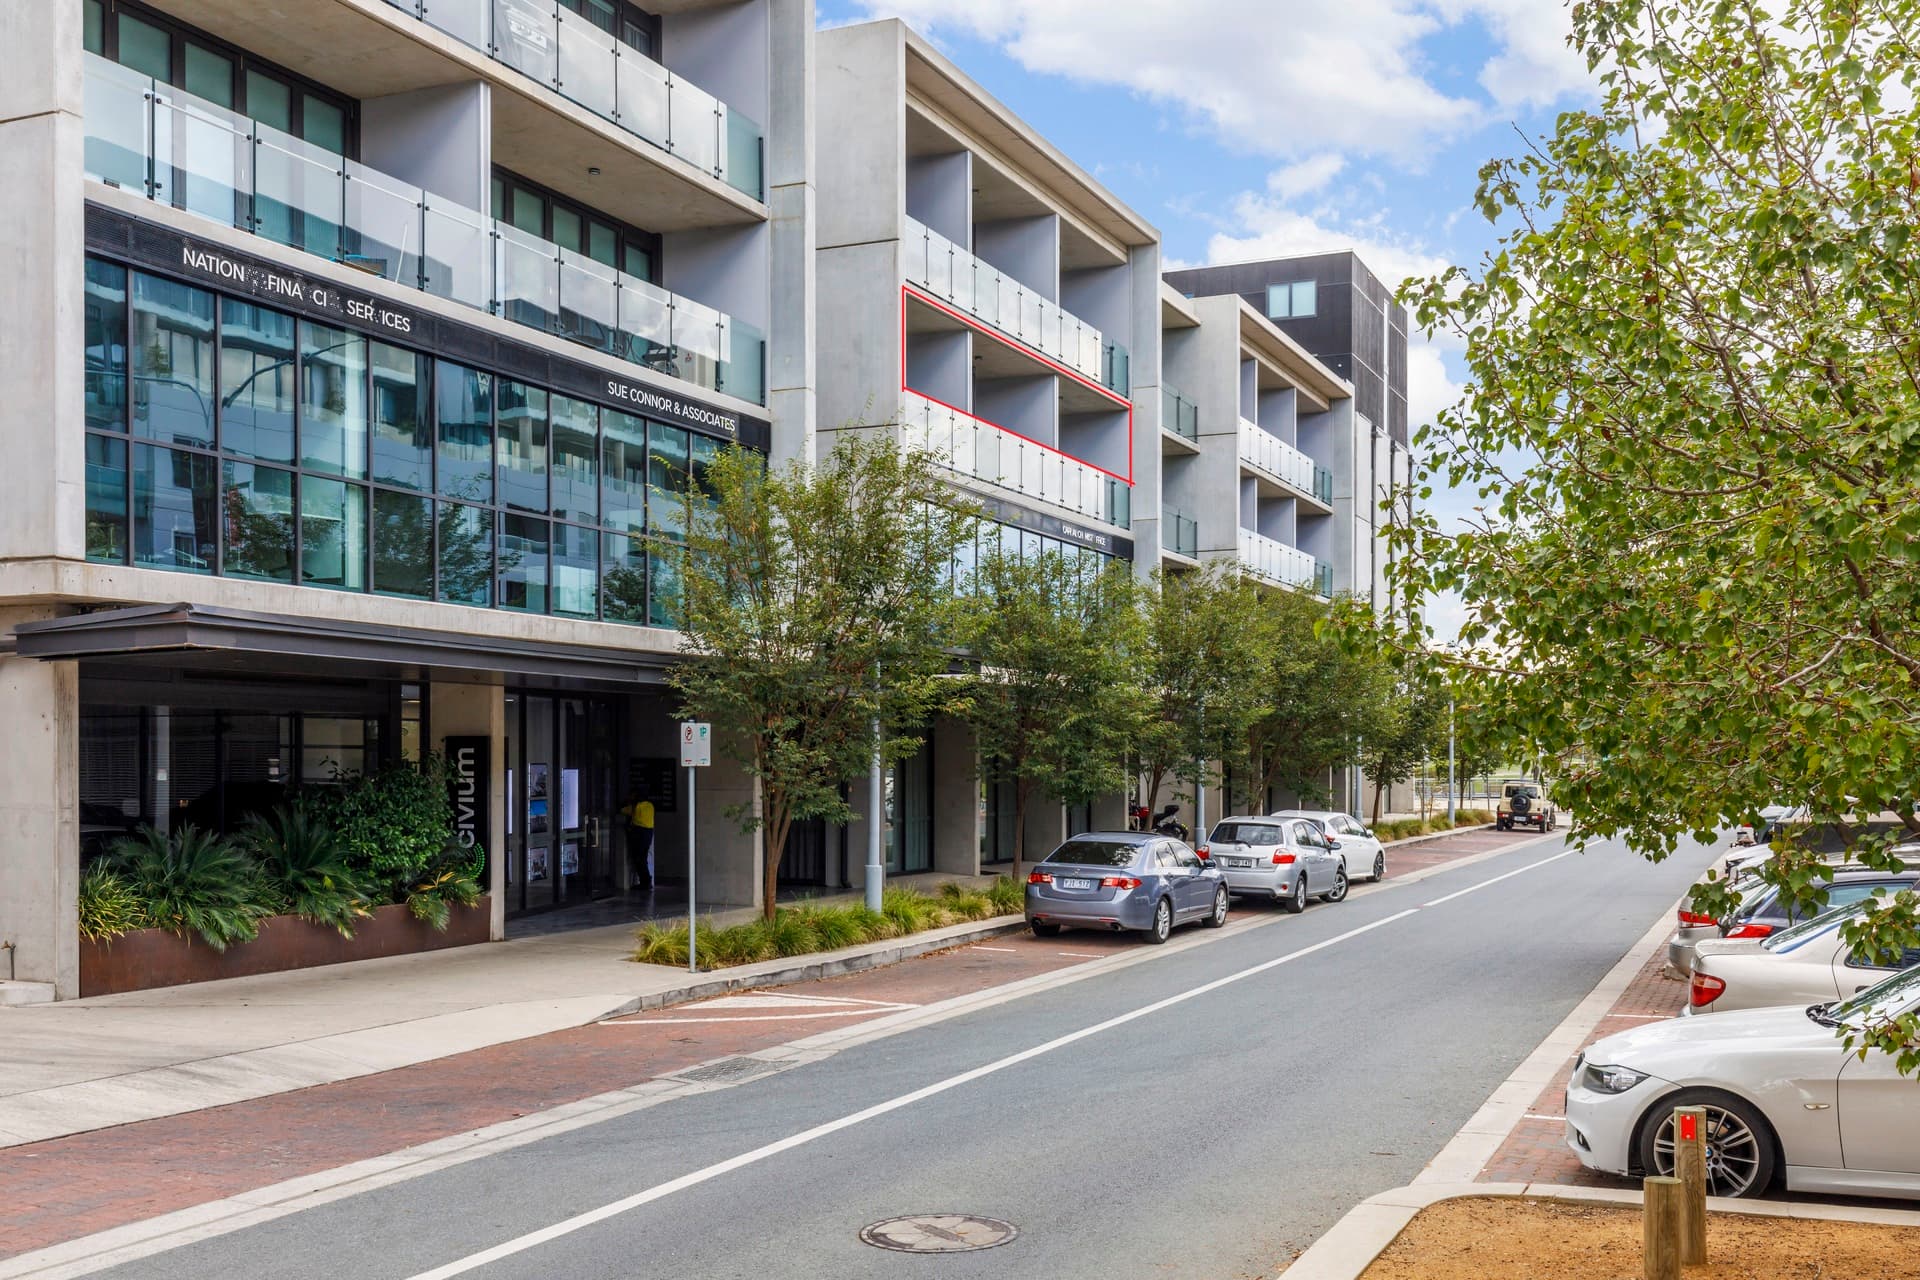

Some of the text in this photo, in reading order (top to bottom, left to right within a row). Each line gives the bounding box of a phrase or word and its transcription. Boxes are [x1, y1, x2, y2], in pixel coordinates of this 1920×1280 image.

[183, 247, 254, 287] NATION
[347, 300, 410, 332] SERICES
[608, 381, 735, 431] SUE CONNOR & ASSOCIATES
[457, 747, 475, 848] civium
